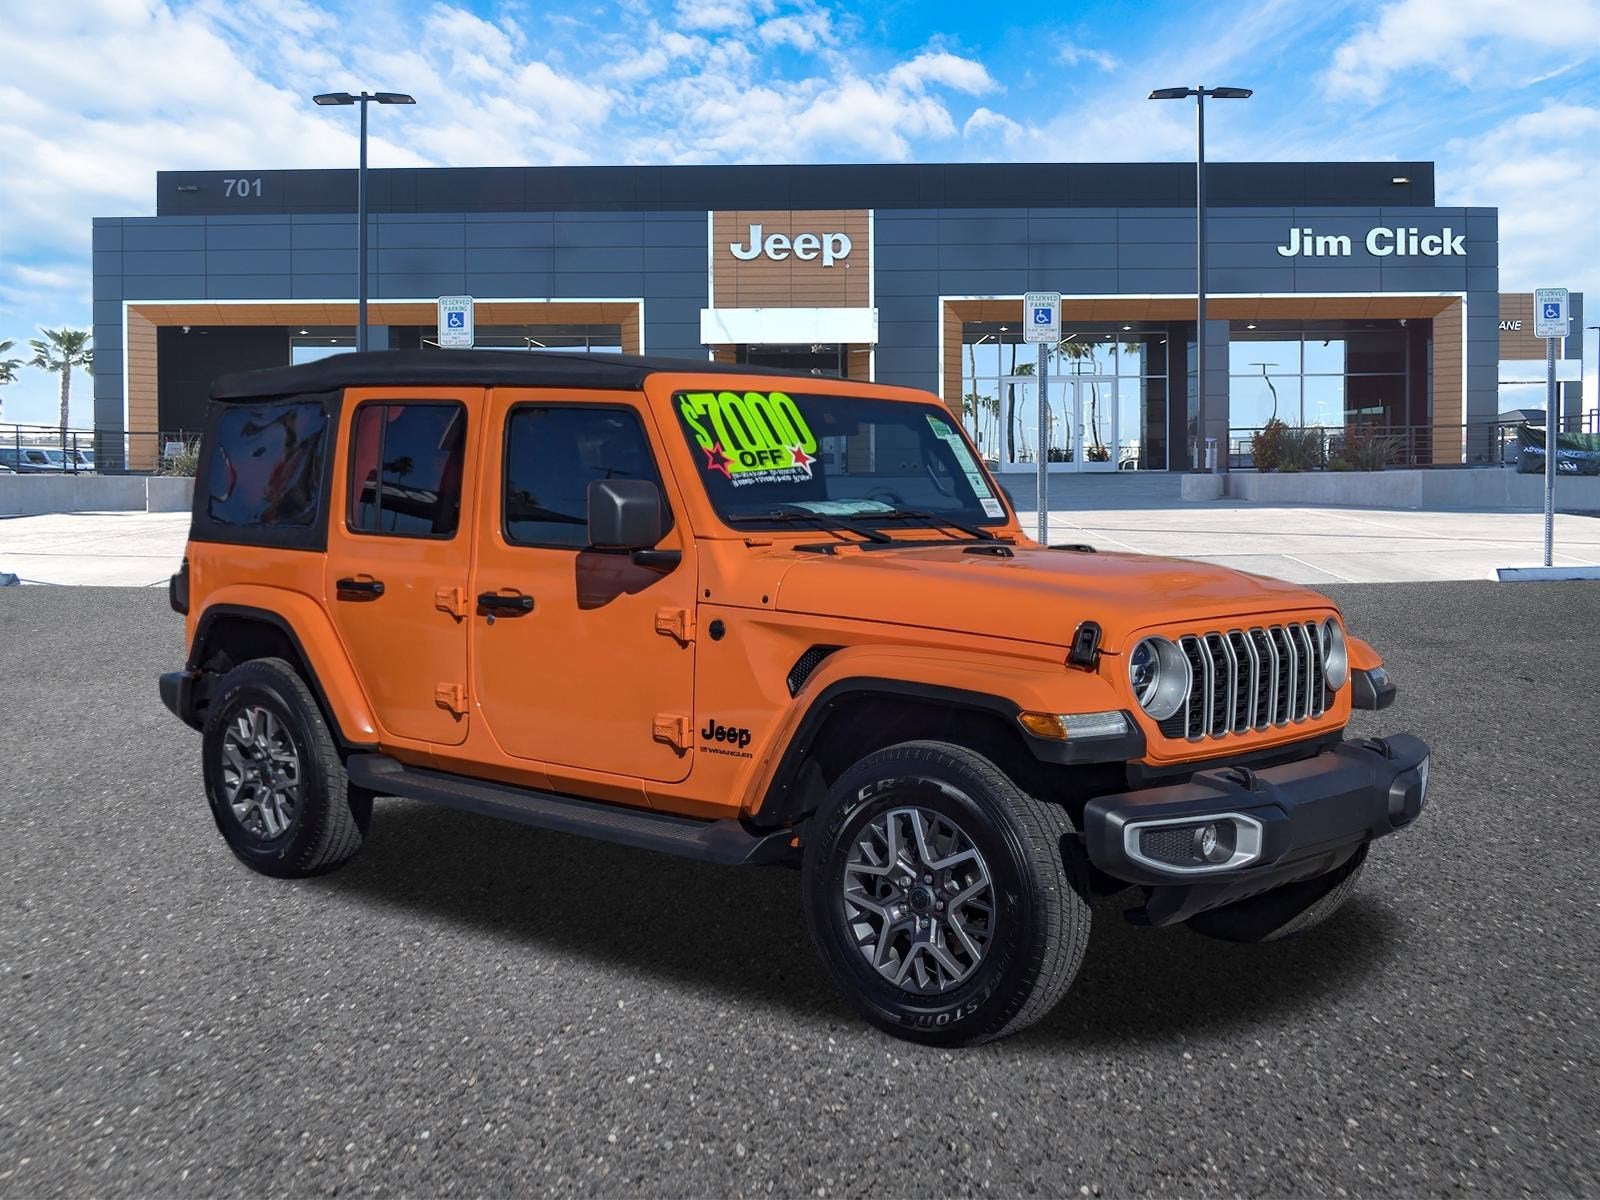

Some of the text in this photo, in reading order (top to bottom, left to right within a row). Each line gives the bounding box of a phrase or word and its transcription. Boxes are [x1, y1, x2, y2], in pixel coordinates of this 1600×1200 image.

[223, 178, 262, 197] 701
[730, 224, 853, 268] Jeep
[1277, 226, 1467, 257] Jim Click
[678, 391, 817, 455] $7000
[738, 449, 783, 469] OFF
[701, 718, 752, 749] Jeep
